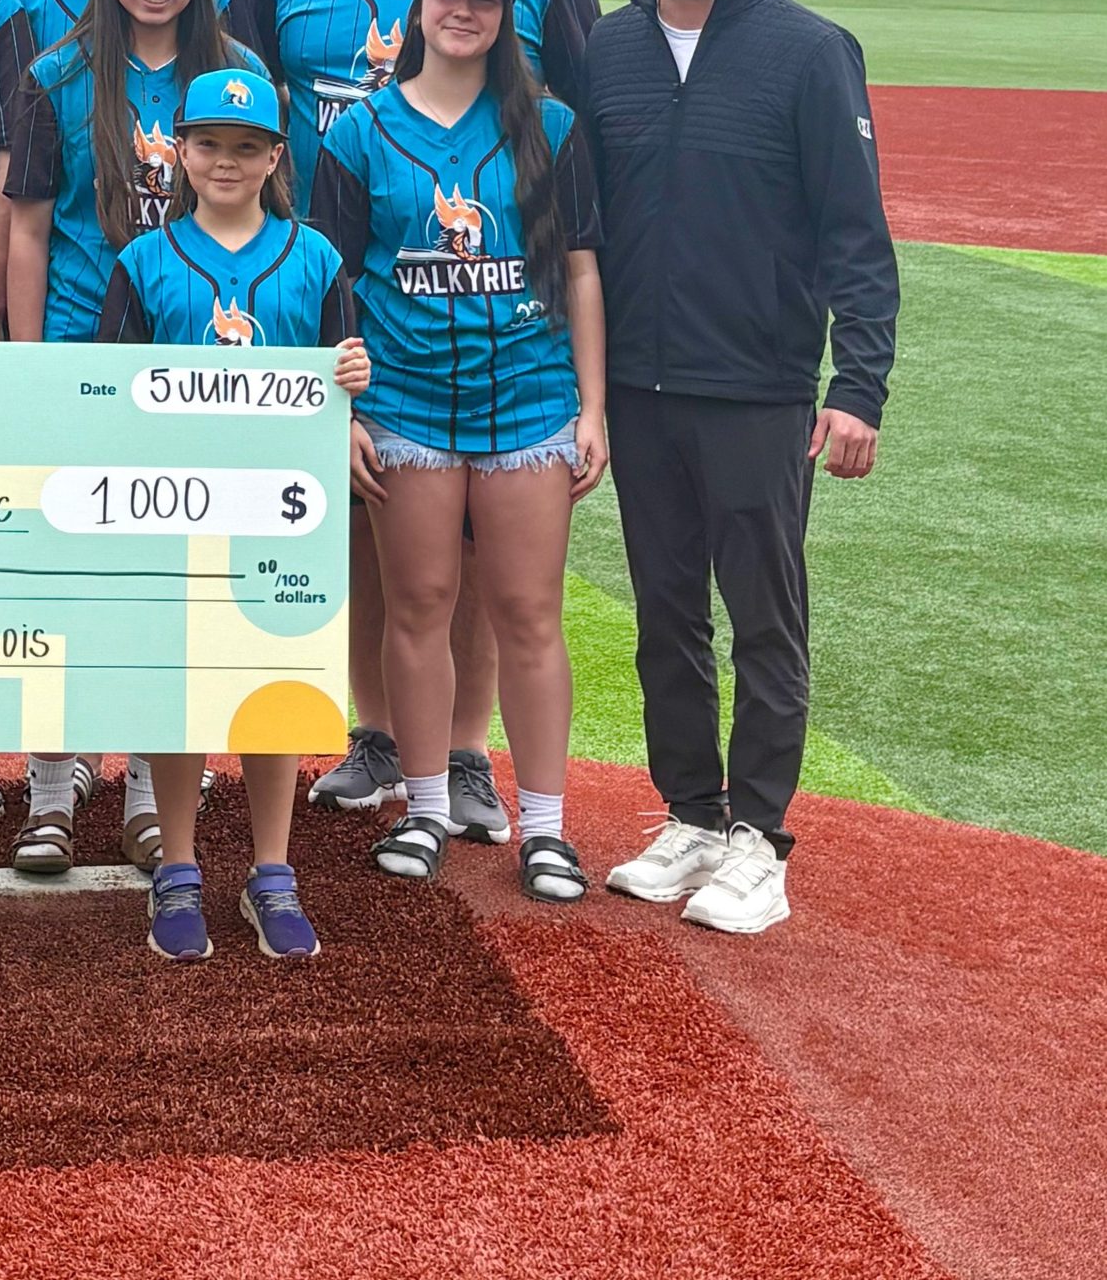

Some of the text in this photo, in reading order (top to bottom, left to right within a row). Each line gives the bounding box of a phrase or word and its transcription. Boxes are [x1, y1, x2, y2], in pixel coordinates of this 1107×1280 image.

[80, 382, 117, 396] Date
[150, 368, 171, 403] 5
[257, 372, 325, 408] 2026
[281, 482, 307, 524] $
[258, 559, 277, 574] 00
[274, 574, 310, 587] /100
[274, 590, 327, 603] dollars
